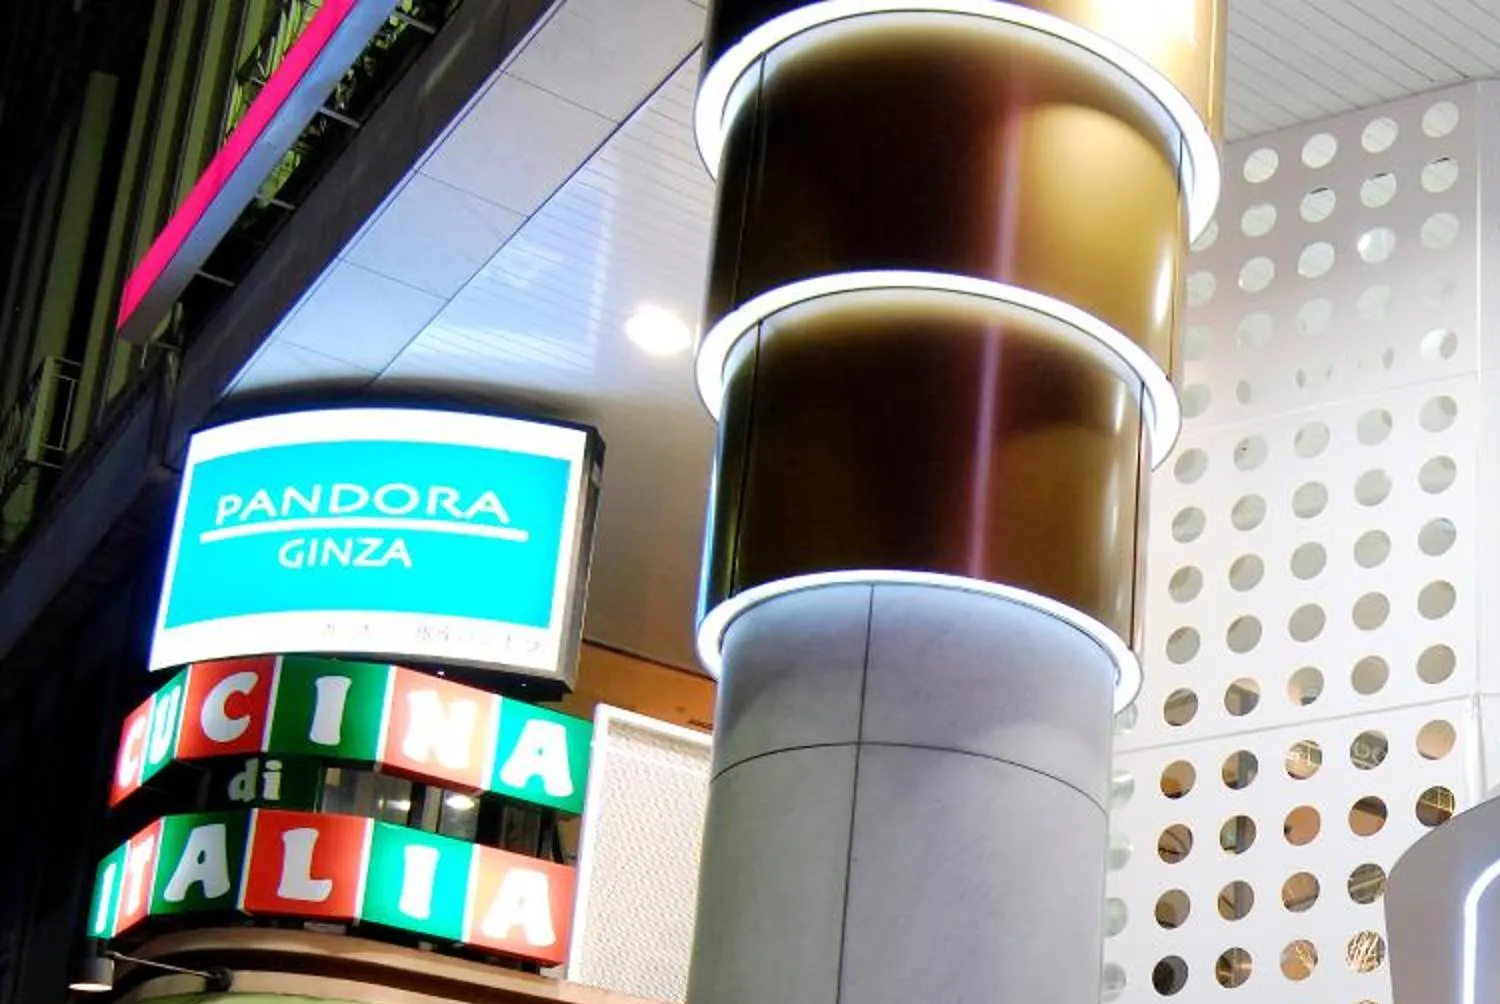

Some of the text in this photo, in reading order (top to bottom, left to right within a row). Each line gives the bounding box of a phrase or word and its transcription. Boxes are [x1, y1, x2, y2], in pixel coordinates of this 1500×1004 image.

[215, 483, 510, 525] PANDORA
[278, 537, 412, 568] GINZA
[118, 672, 573, 796] CUCINA
[228, 759, 282, 802] di
[95, 823, 556, 947] ITALIA
